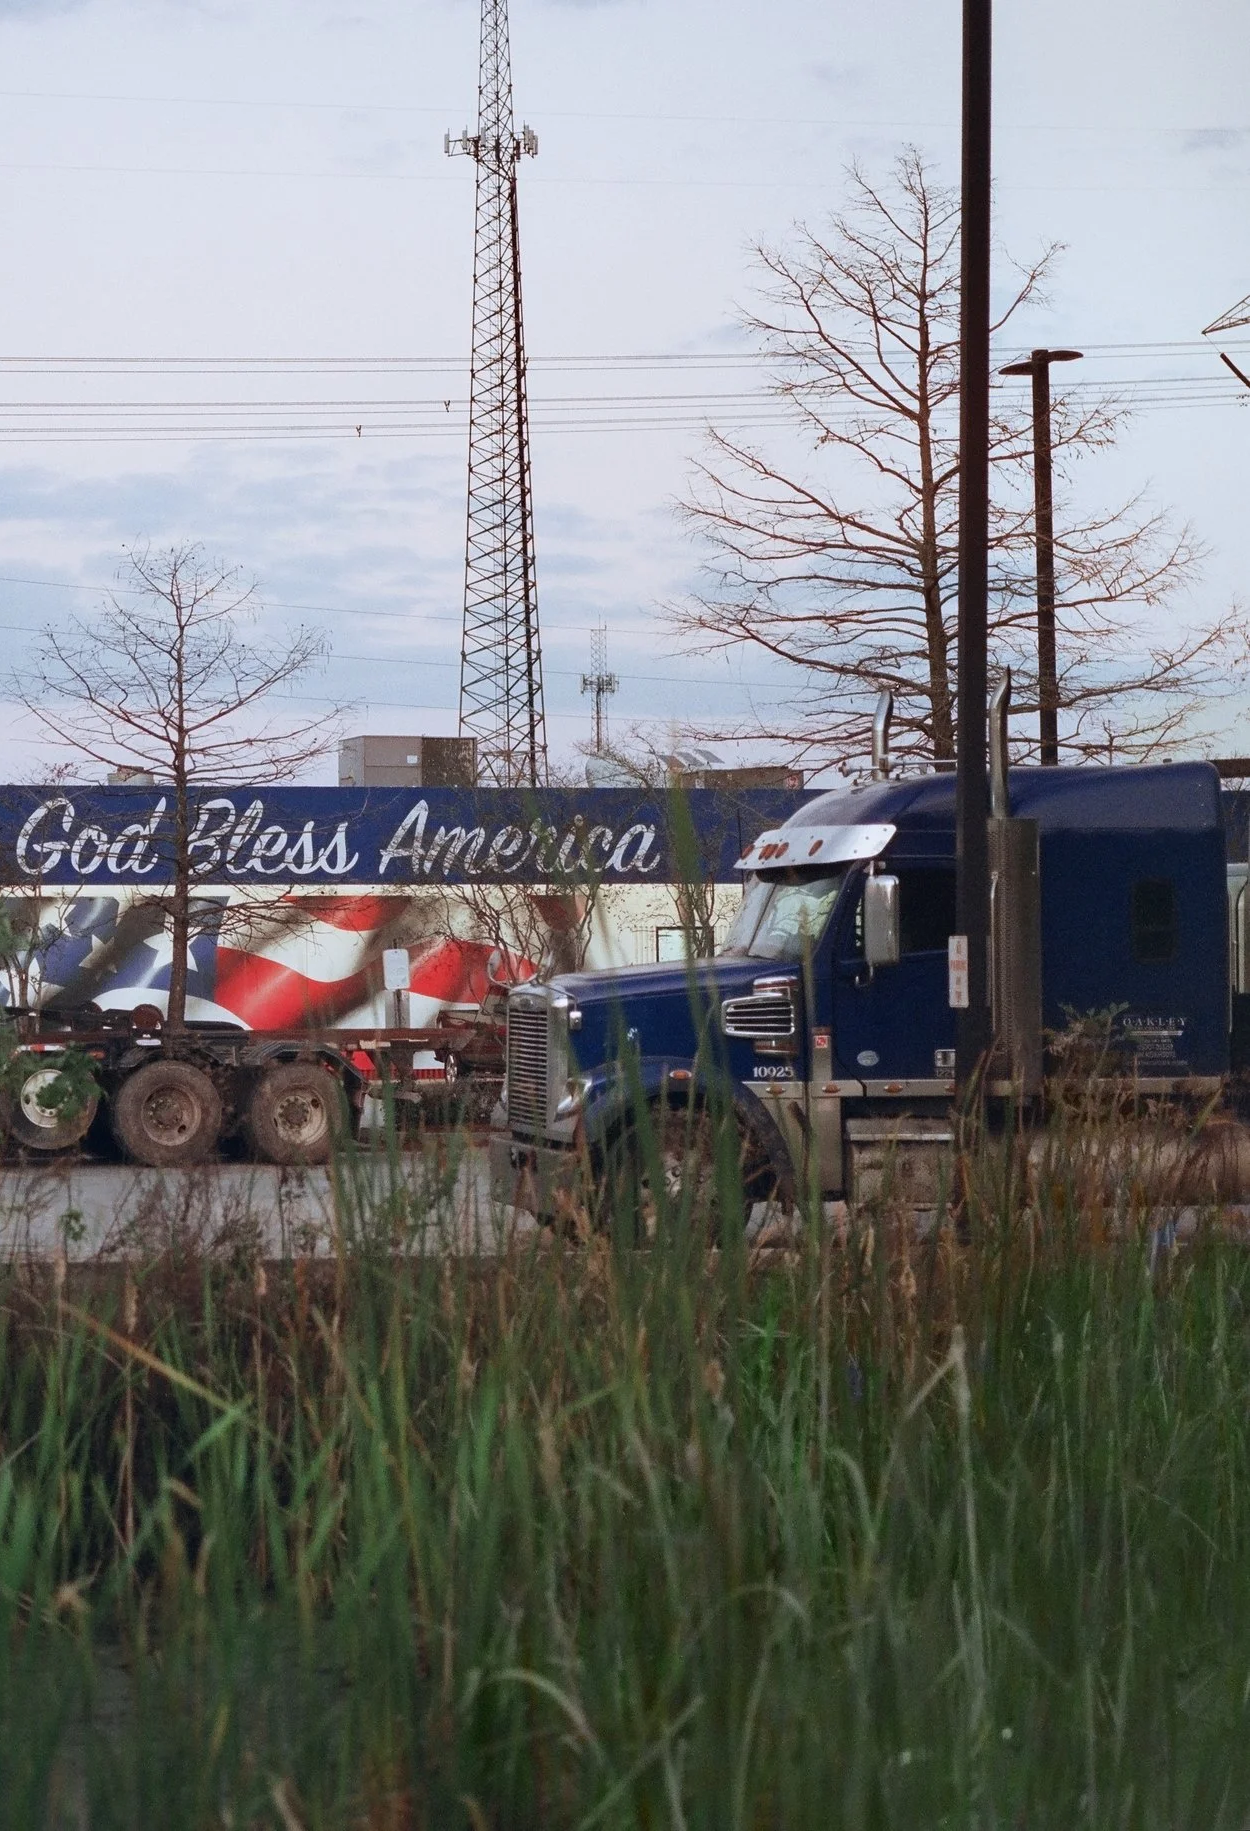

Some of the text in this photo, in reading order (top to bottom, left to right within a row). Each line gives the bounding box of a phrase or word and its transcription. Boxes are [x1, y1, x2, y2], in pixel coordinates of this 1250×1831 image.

[16, 797, 661, 875] God Bless America
[753, 1066, 794, 1078] 10925
